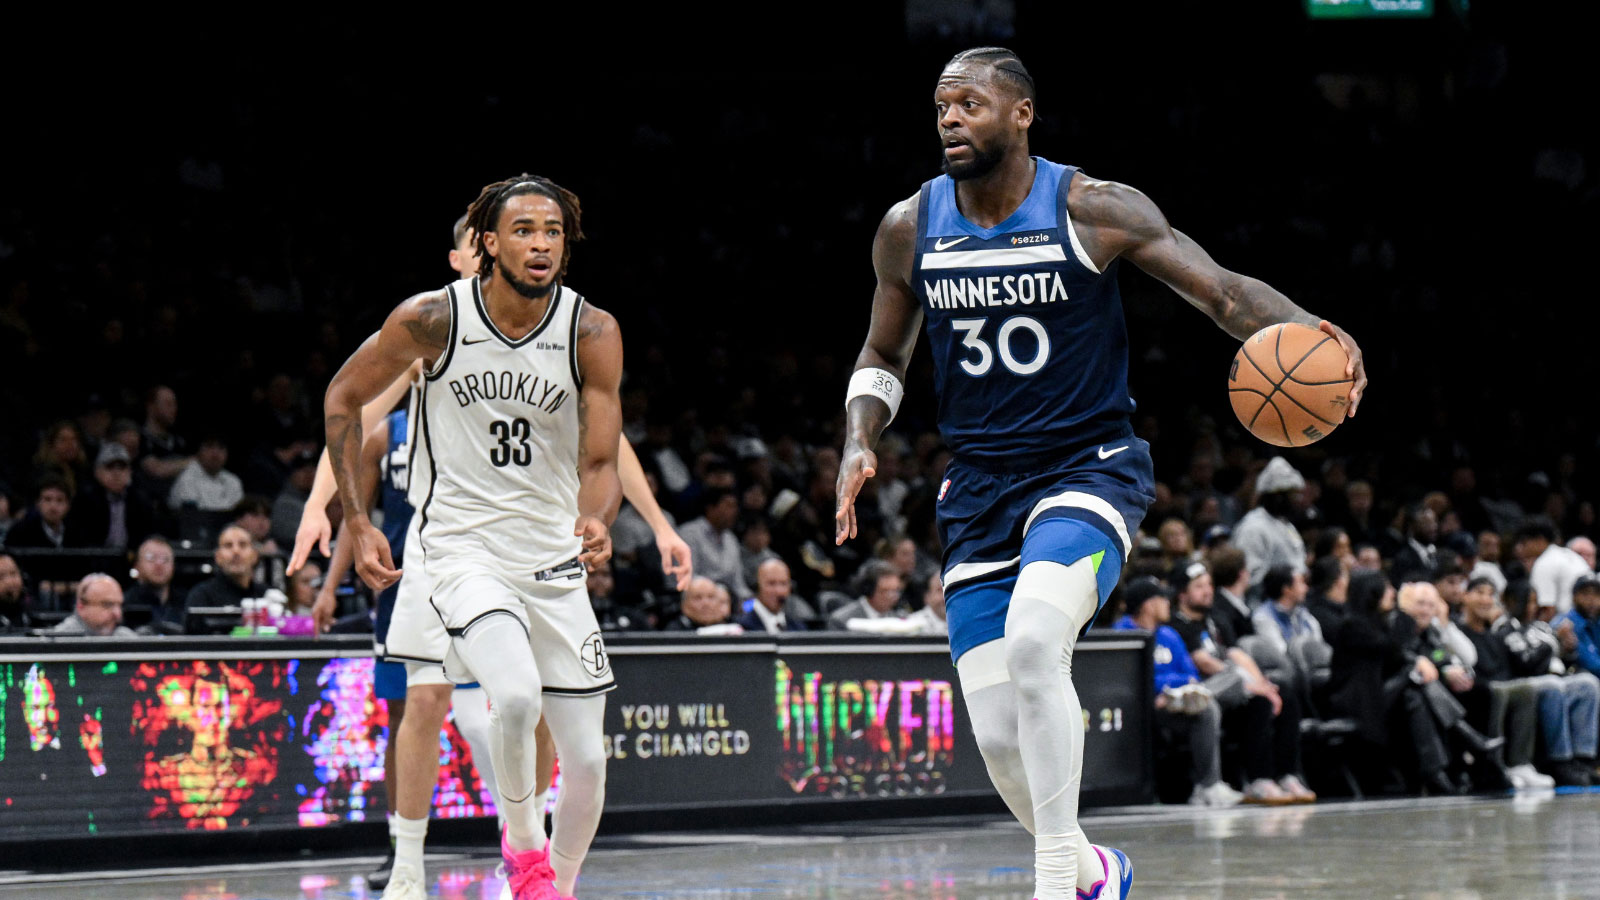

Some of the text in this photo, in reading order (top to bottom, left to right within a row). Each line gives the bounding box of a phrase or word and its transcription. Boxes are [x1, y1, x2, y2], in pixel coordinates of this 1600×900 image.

[1017, 233, 1049, 244] sezzle
[924, 271, 1069, 309] MINNESOTA
[951, 315, 1051, 376] 30
[449, 371, 569, 414] BROOKLYN
[489, 417, 532, 467] 33
[620, 702, 730, 730] YOU WILL
[1099, 707, 1123, 732] 21
[603, 729, 750, 760] BE CHANGED
